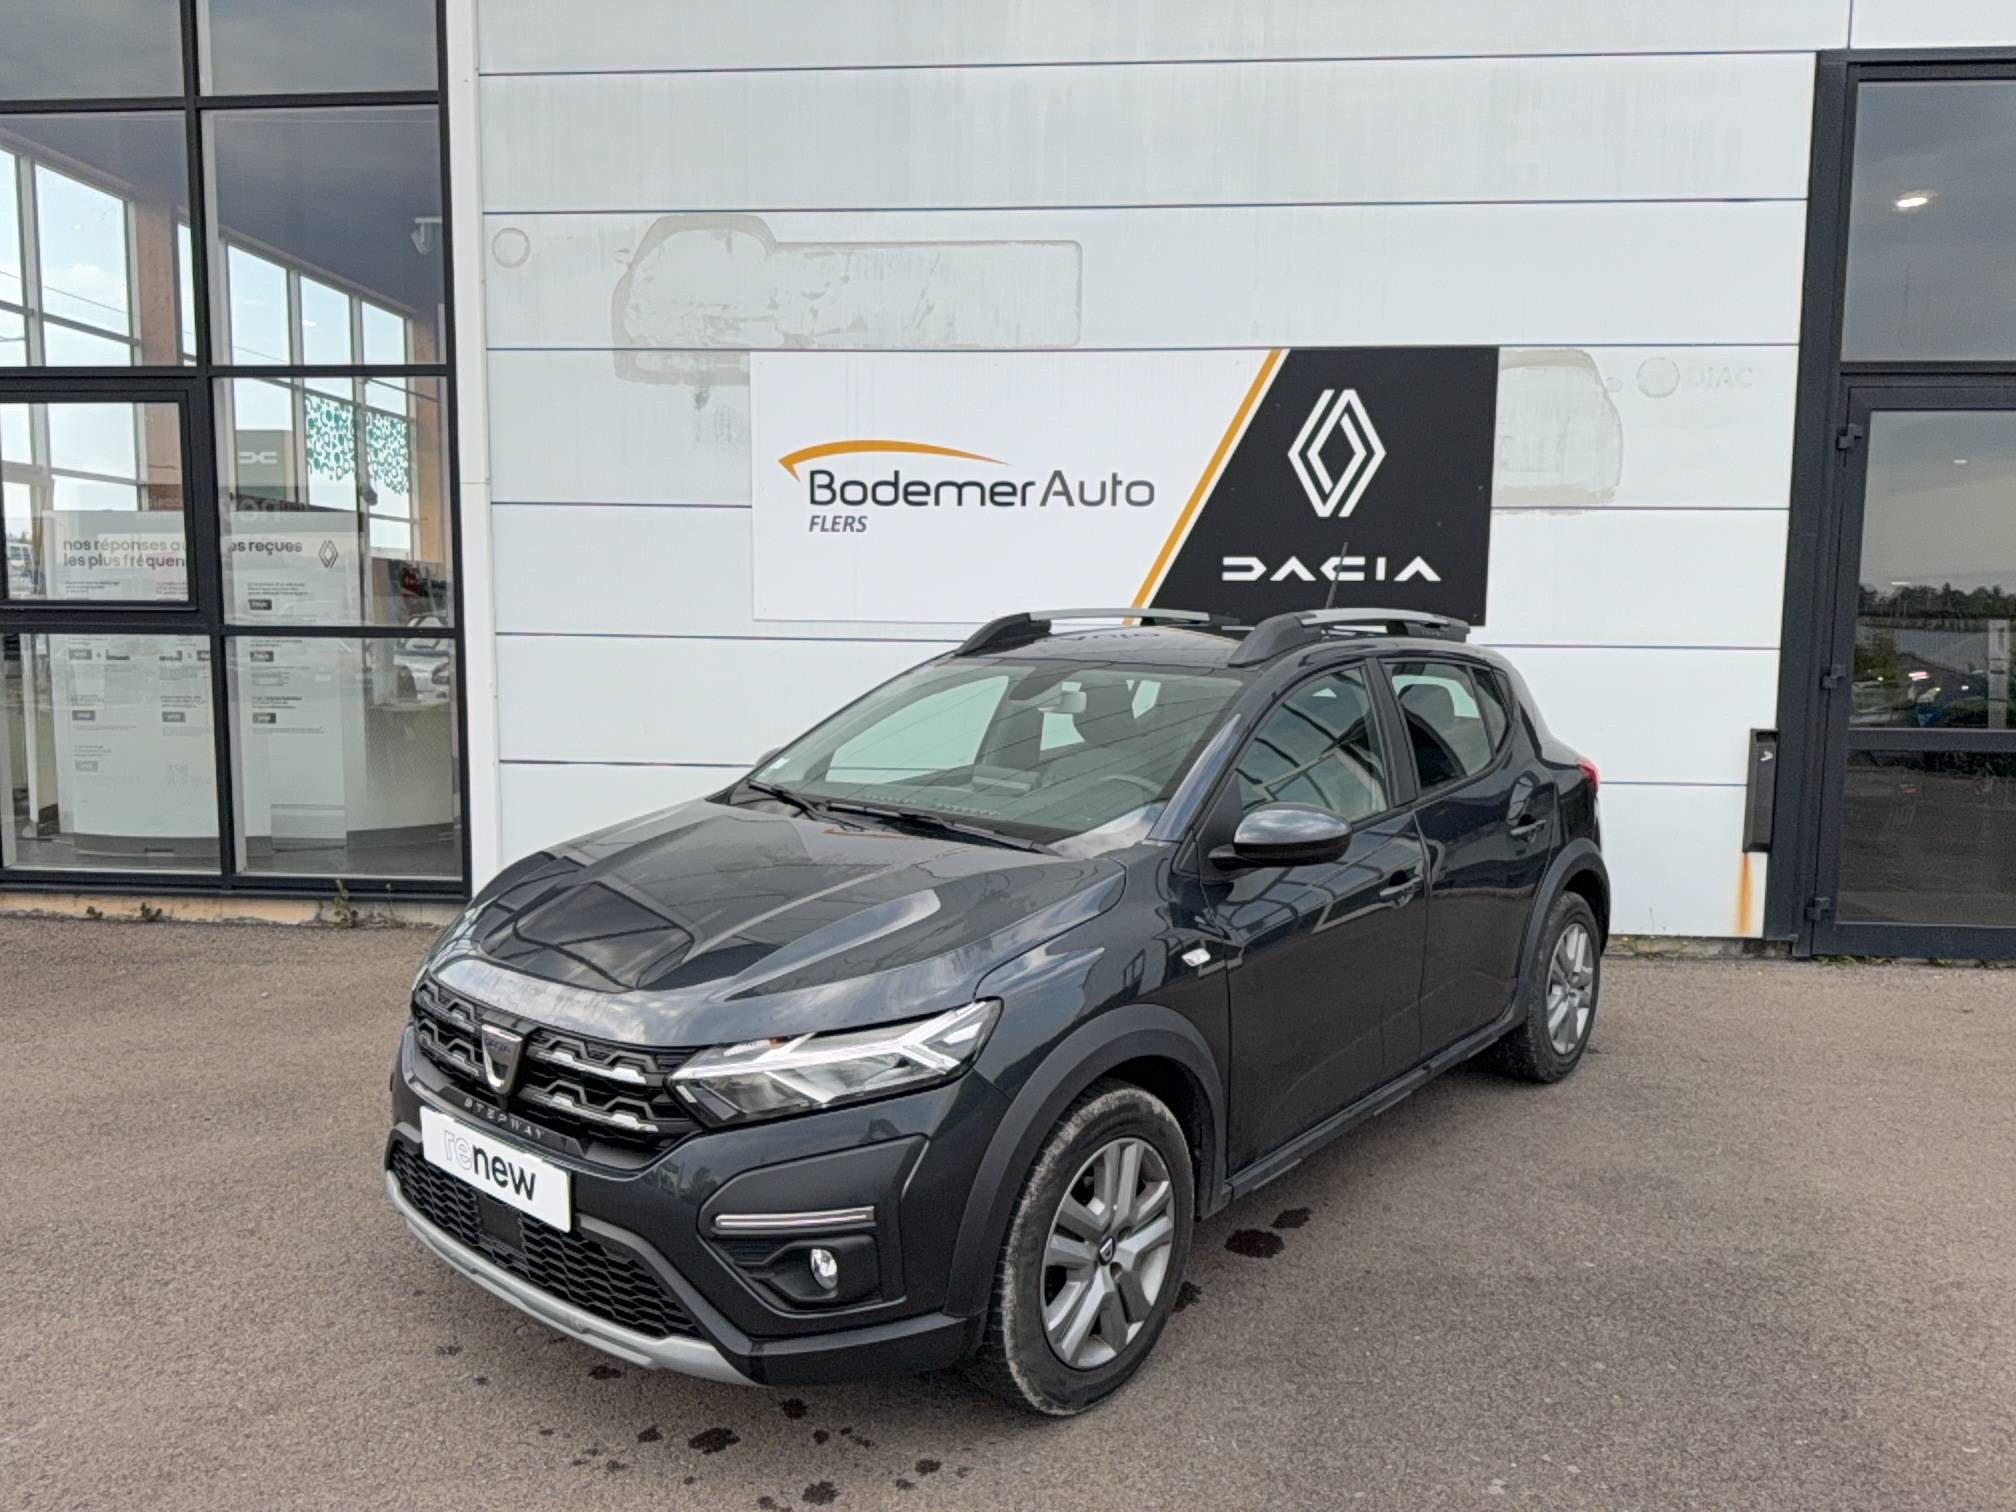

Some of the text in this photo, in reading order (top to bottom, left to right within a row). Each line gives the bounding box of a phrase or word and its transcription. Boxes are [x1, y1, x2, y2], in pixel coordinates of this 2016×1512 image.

[809, 515, 868, 533] FLERS
[63, 540, 91, 551] nos
[94, 538, 167, 554] réponses
[248, 541, 303, 556] reçues
[64, 554, 86, 567] les
[88, 554, 121, 570] plus
[1221, 556, 1442, 581] DACIA
[463, 1097, 542, 1140] STEPWAY
[443, 1129, 536, 1201] renew
